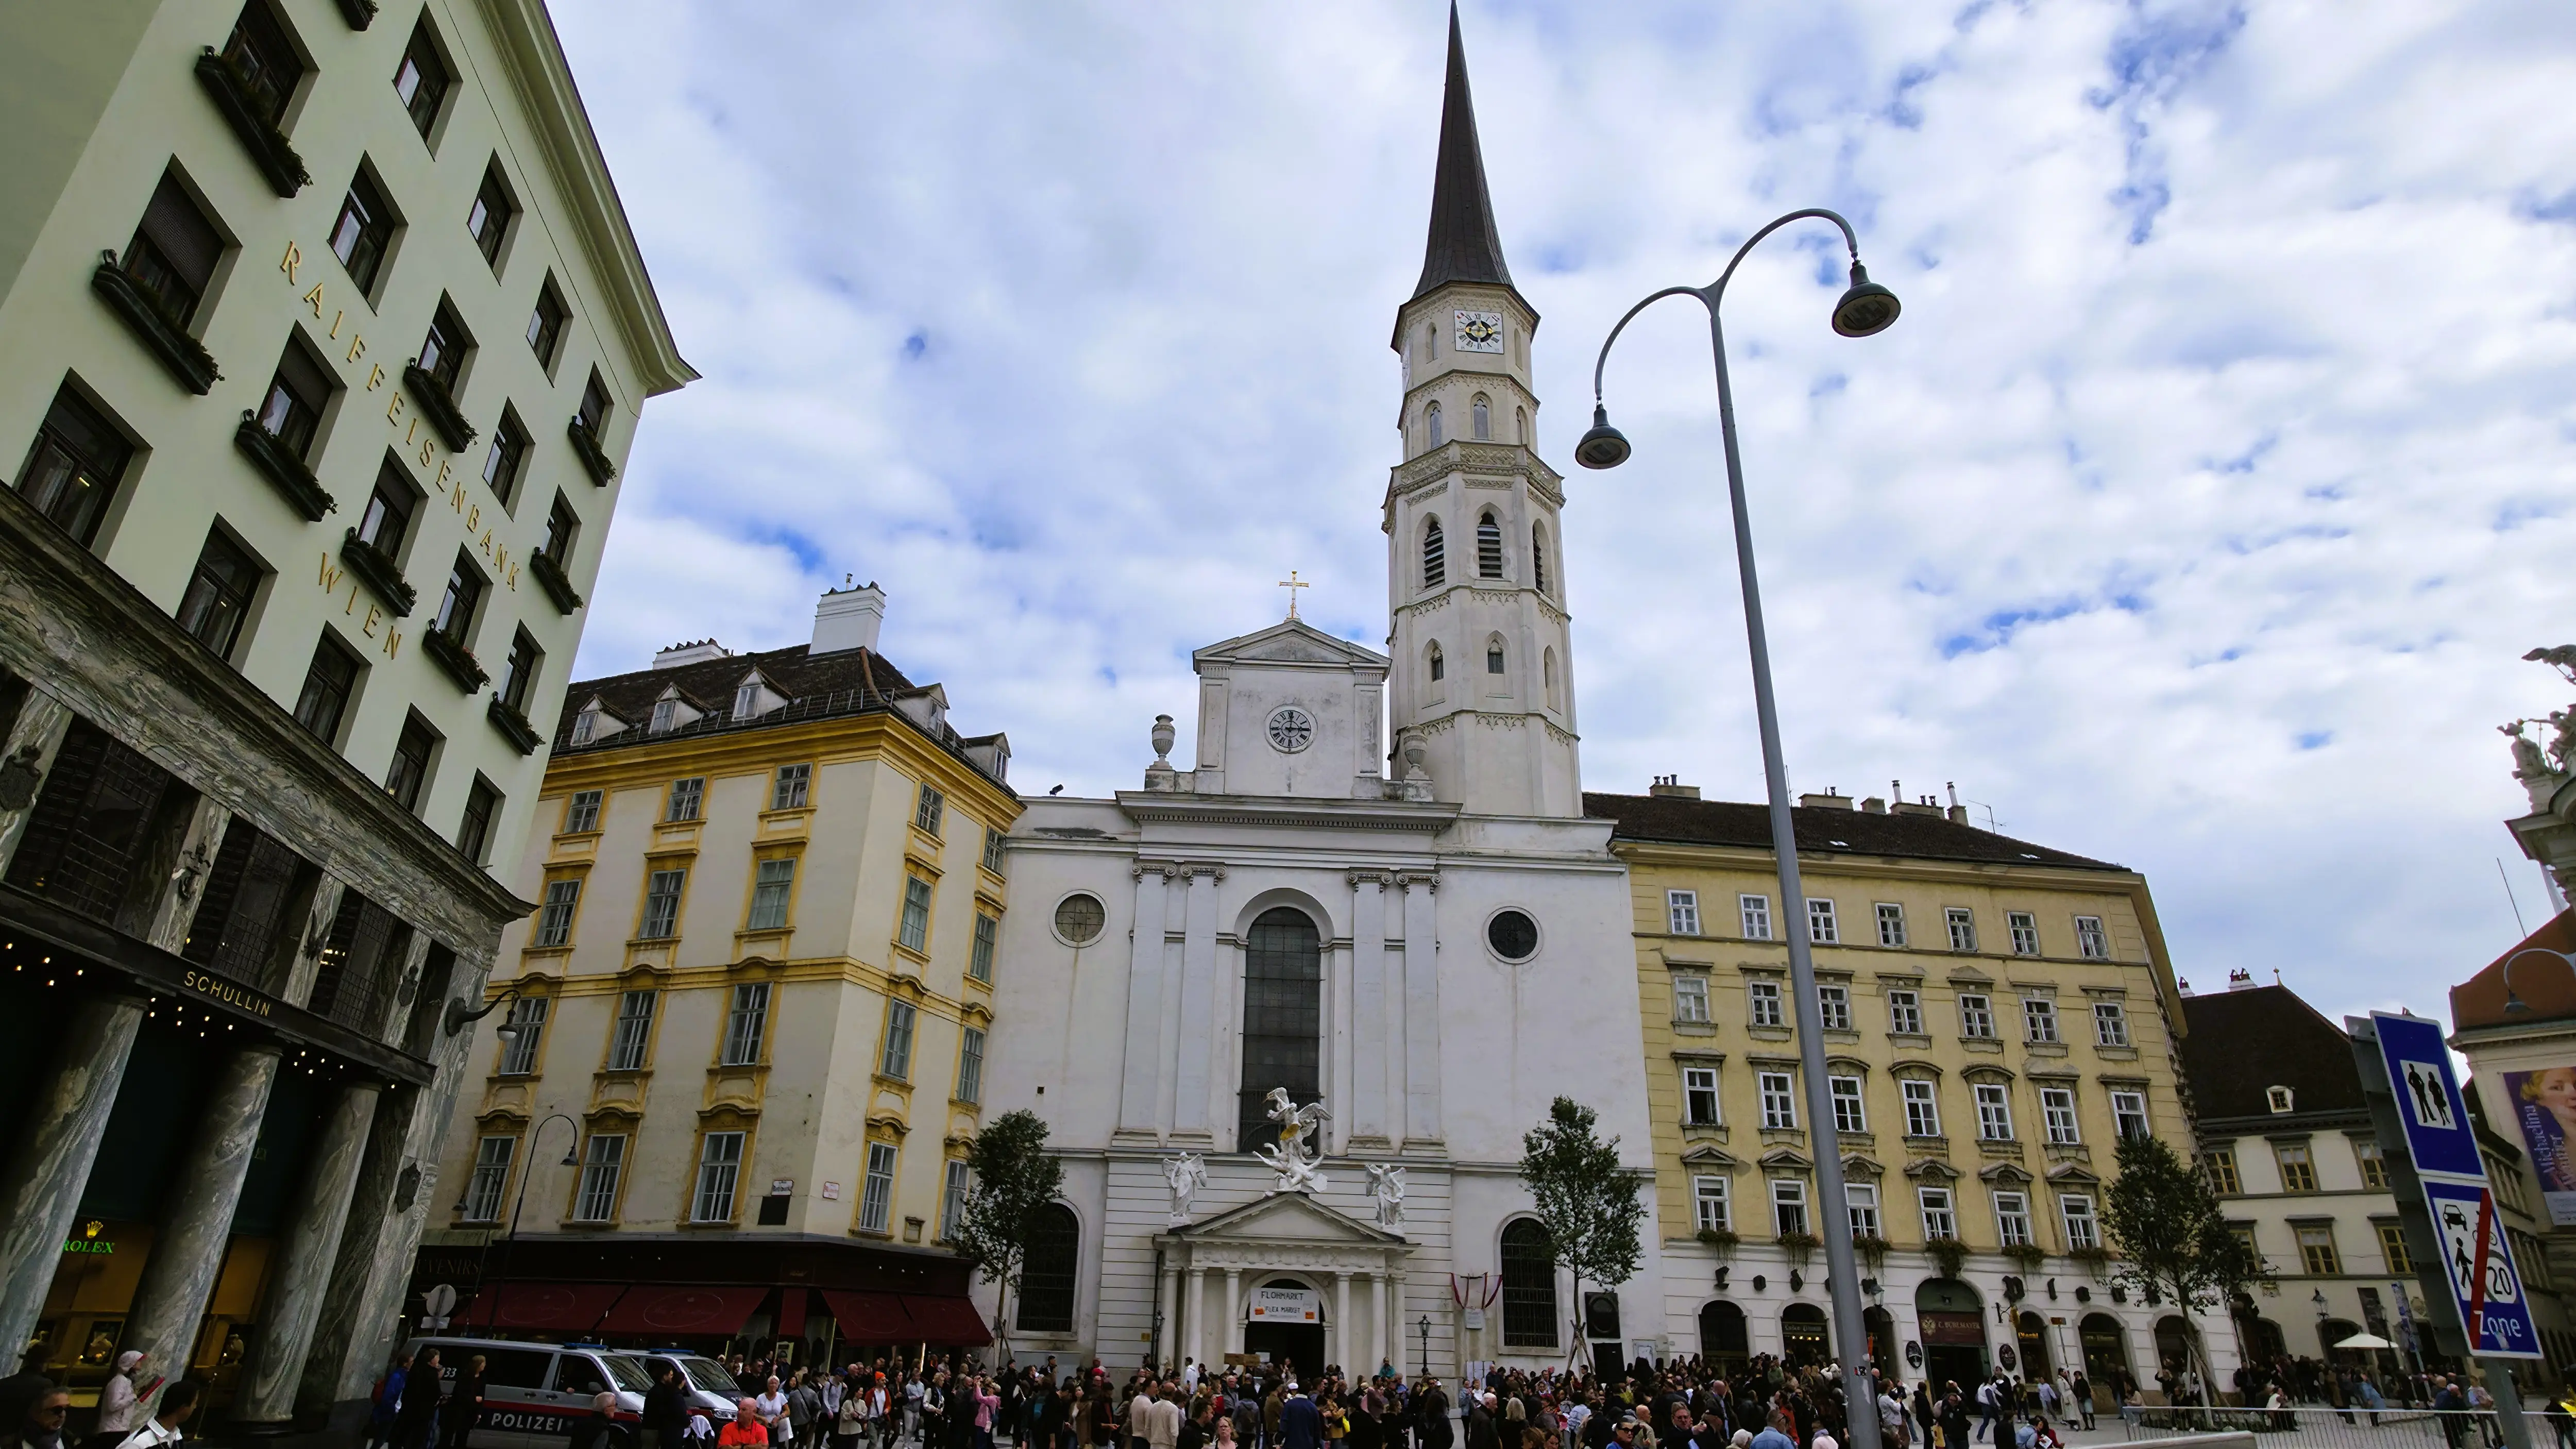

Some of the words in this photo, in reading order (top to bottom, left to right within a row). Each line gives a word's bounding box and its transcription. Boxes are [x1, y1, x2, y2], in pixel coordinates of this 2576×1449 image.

[280, 241, 520, 592] RAIFFEISENBANK
[318, 552, 401, 660] WIEN
[183, 971, 271, 1017] SCHULLIN
[2487, 1266, 2512, 1295] 20
[1261, 1291, 1304, 1301] FLOHMARKT
[2473, 1310, 2521, 1337] Zone
[444, 1367, 457, 1377] 33
[491, 1412, 564, 1432] POLIZEI
